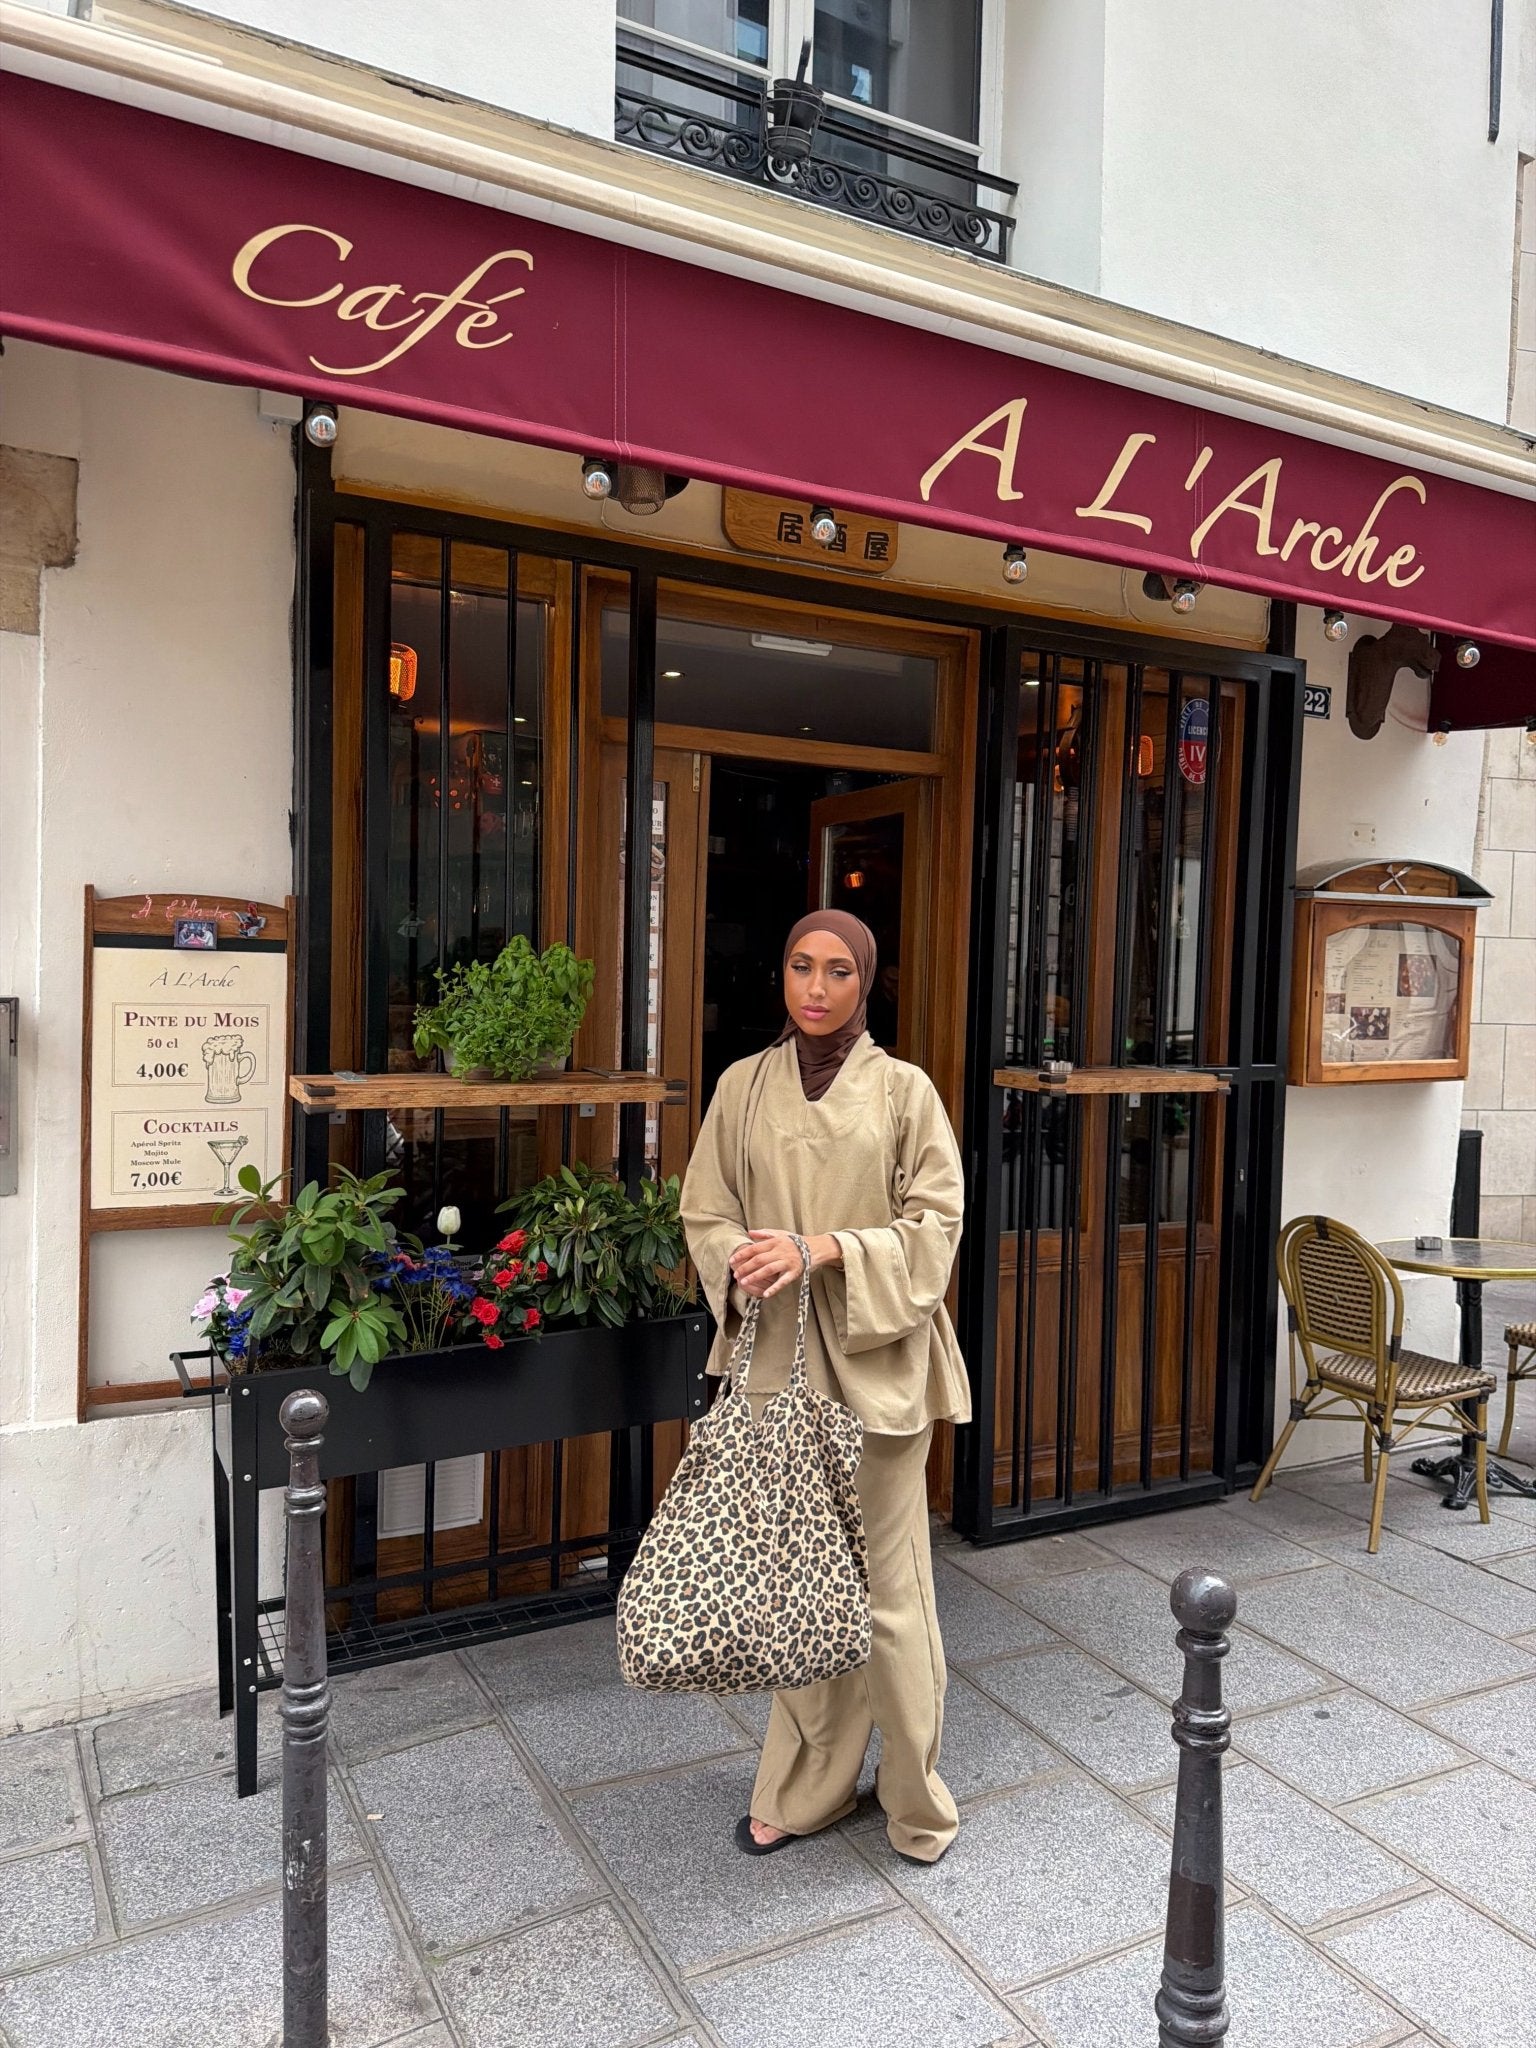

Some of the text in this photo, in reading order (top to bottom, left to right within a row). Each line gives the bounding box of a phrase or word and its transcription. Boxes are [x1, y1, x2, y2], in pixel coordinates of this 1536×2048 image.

[232, 223, 535, 376] Café
[919, 397, 1428, 588] A L'Arche
[1190, 745, 1206, 762] IV
[149, 965, 240, 987] À L'Arche
[123, 1012, 178, 1027] PINTE
[213, 1012, 259, 1028] MOIS
[147, 1039, 179, 1048] 50 cl
[136, 1063, 189, 1080] 4,00€
[143, 1118, 239, 1134] COCKTAILS
[130, 1140, 182, 1148] Apérol Spritz
[130, 1159, 161, 1167] Moscow
[130, 1171, 182, 1189] 7,00€
